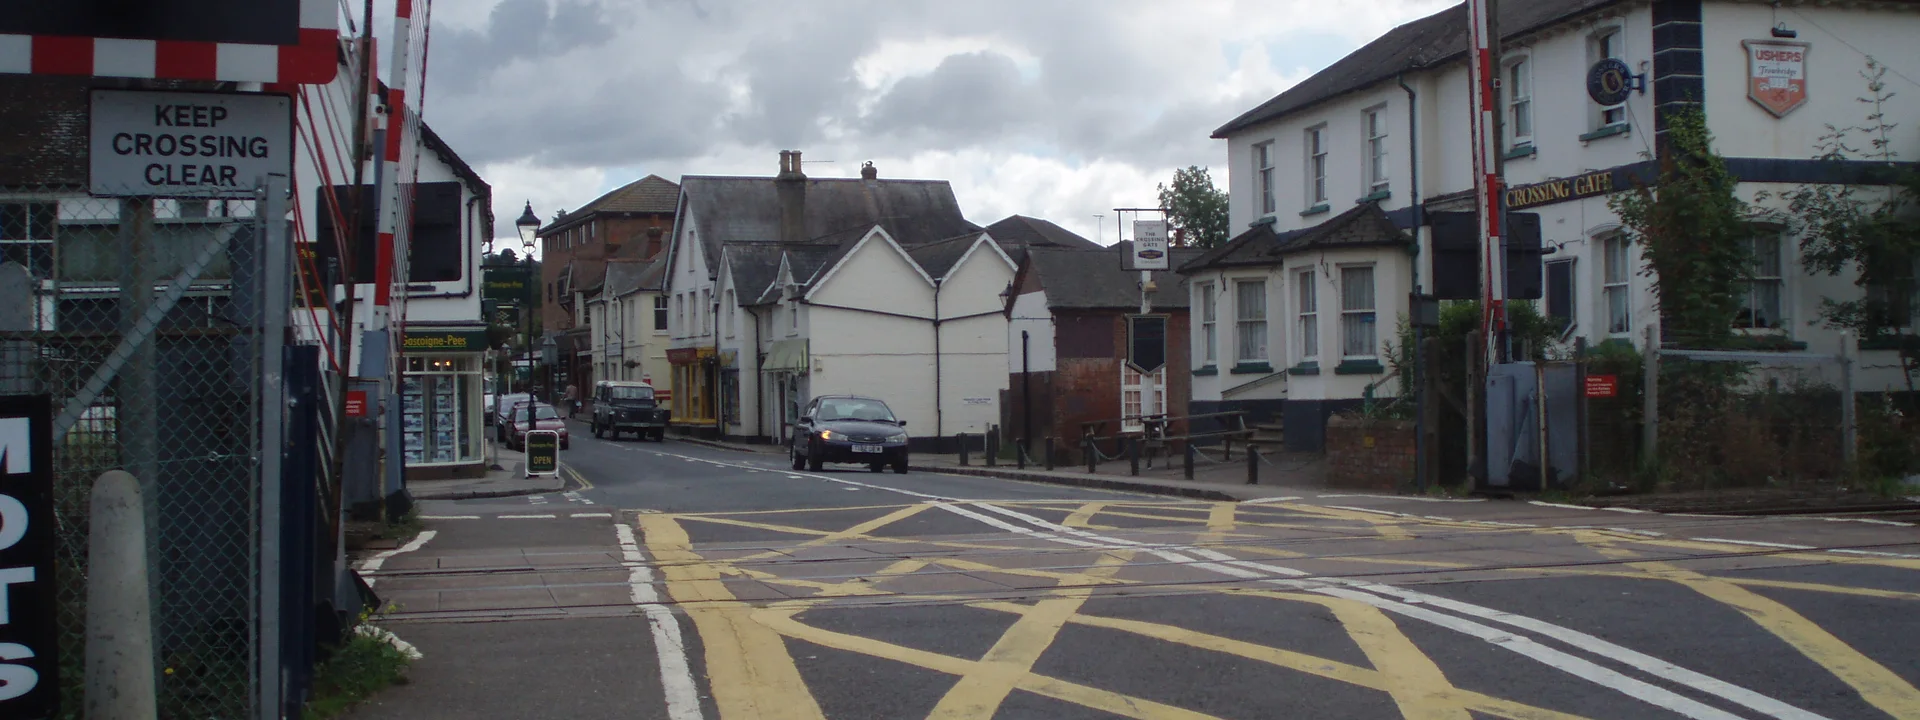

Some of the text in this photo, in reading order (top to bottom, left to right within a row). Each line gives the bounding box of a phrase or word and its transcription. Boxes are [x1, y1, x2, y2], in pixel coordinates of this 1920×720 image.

[1756, 49, 1801, 62] USHERS
[1758, 65, 1797, 76] Trowbridge
[154, 104, 228, 128] KEEP
[112, 132, 268, 158] CROSSING
[144, 163, 237, 187] CLEAR
[1506, 171, 1613, 208] CROSSING GATE
[533, 456, 552, 465] OPEN
